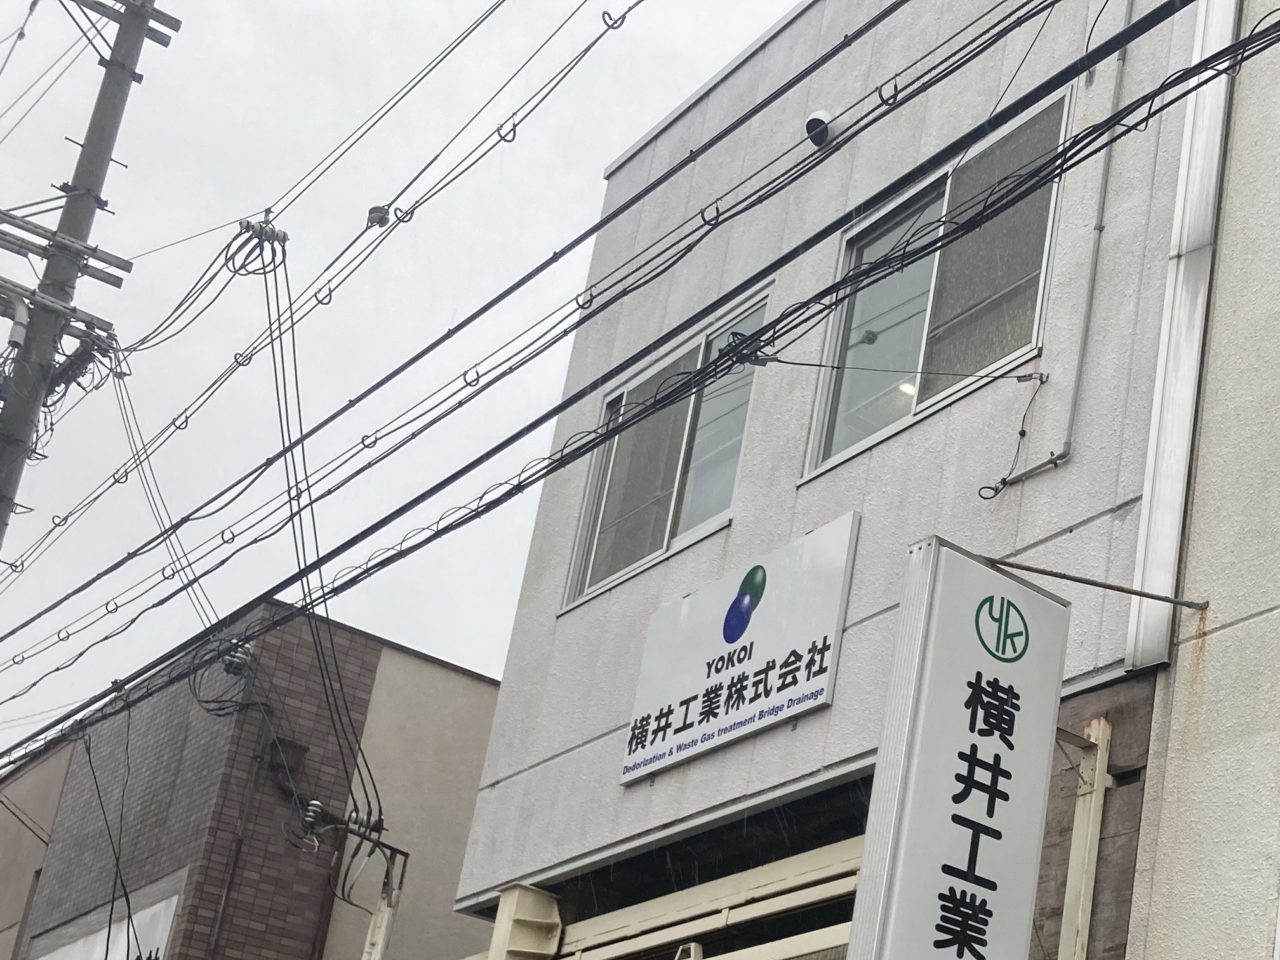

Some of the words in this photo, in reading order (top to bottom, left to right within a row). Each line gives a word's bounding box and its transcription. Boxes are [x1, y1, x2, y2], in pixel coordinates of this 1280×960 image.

[627, 635, 831, 756] 横井工業株式会社
[706, 641, 754, 679] YOKOI
[668, 746, 674, 757] &
[676, 738, 698, 753] Waste
[700, 730, 715, 744] Gas
[717, 716, 756, 737] treatment
[758, 703, 785, 721] Bridge
[787, 686, 825, 709] Drainage
